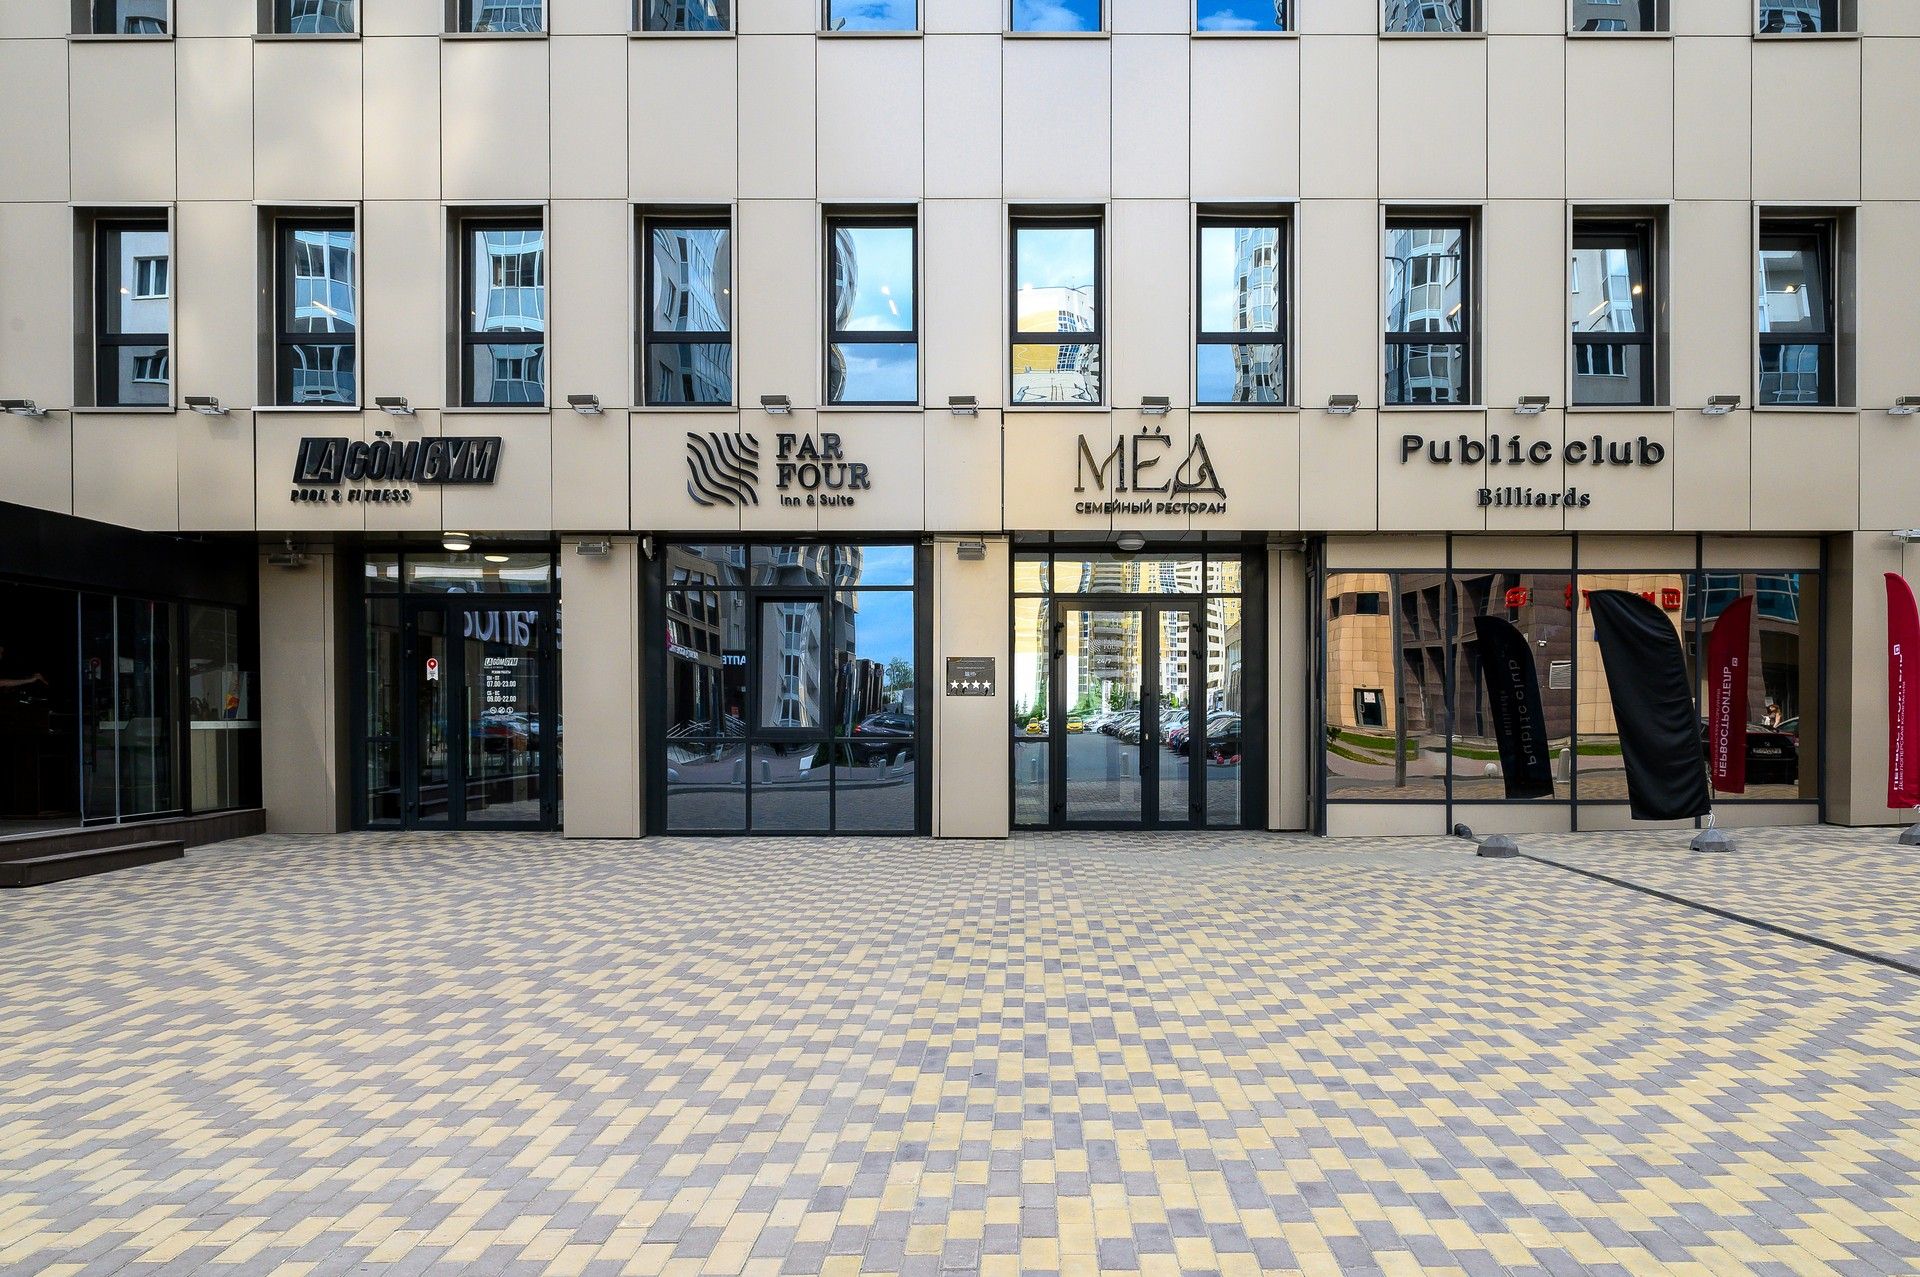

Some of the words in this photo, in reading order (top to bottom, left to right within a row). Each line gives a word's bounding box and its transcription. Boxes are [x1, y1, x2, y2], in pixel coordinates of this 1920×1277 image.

[776, 432, 843, 459] FAR
[1401, 434, 1552, 465] Public
[1563, 434, 1665, 465] club
[1074, 425, 1227, 500] МЁД
[776, 463, 871, 490] FOUR
[291, 489, 326, 502] POOL
[331, 489, 342, 502] &
[347, 489, 411, 502] FITNESS
[780, 494, 801, 506] Inn
[806, 494, 816, 506] &
[820, 494, 855, 506] Suite
[1075, 499, 1153, 514] СЕМЕЙНЫЙ
[1156, 502, 1227, 514] РЕСТОРАН
[1477, 486, 1591, 507] Billiards
